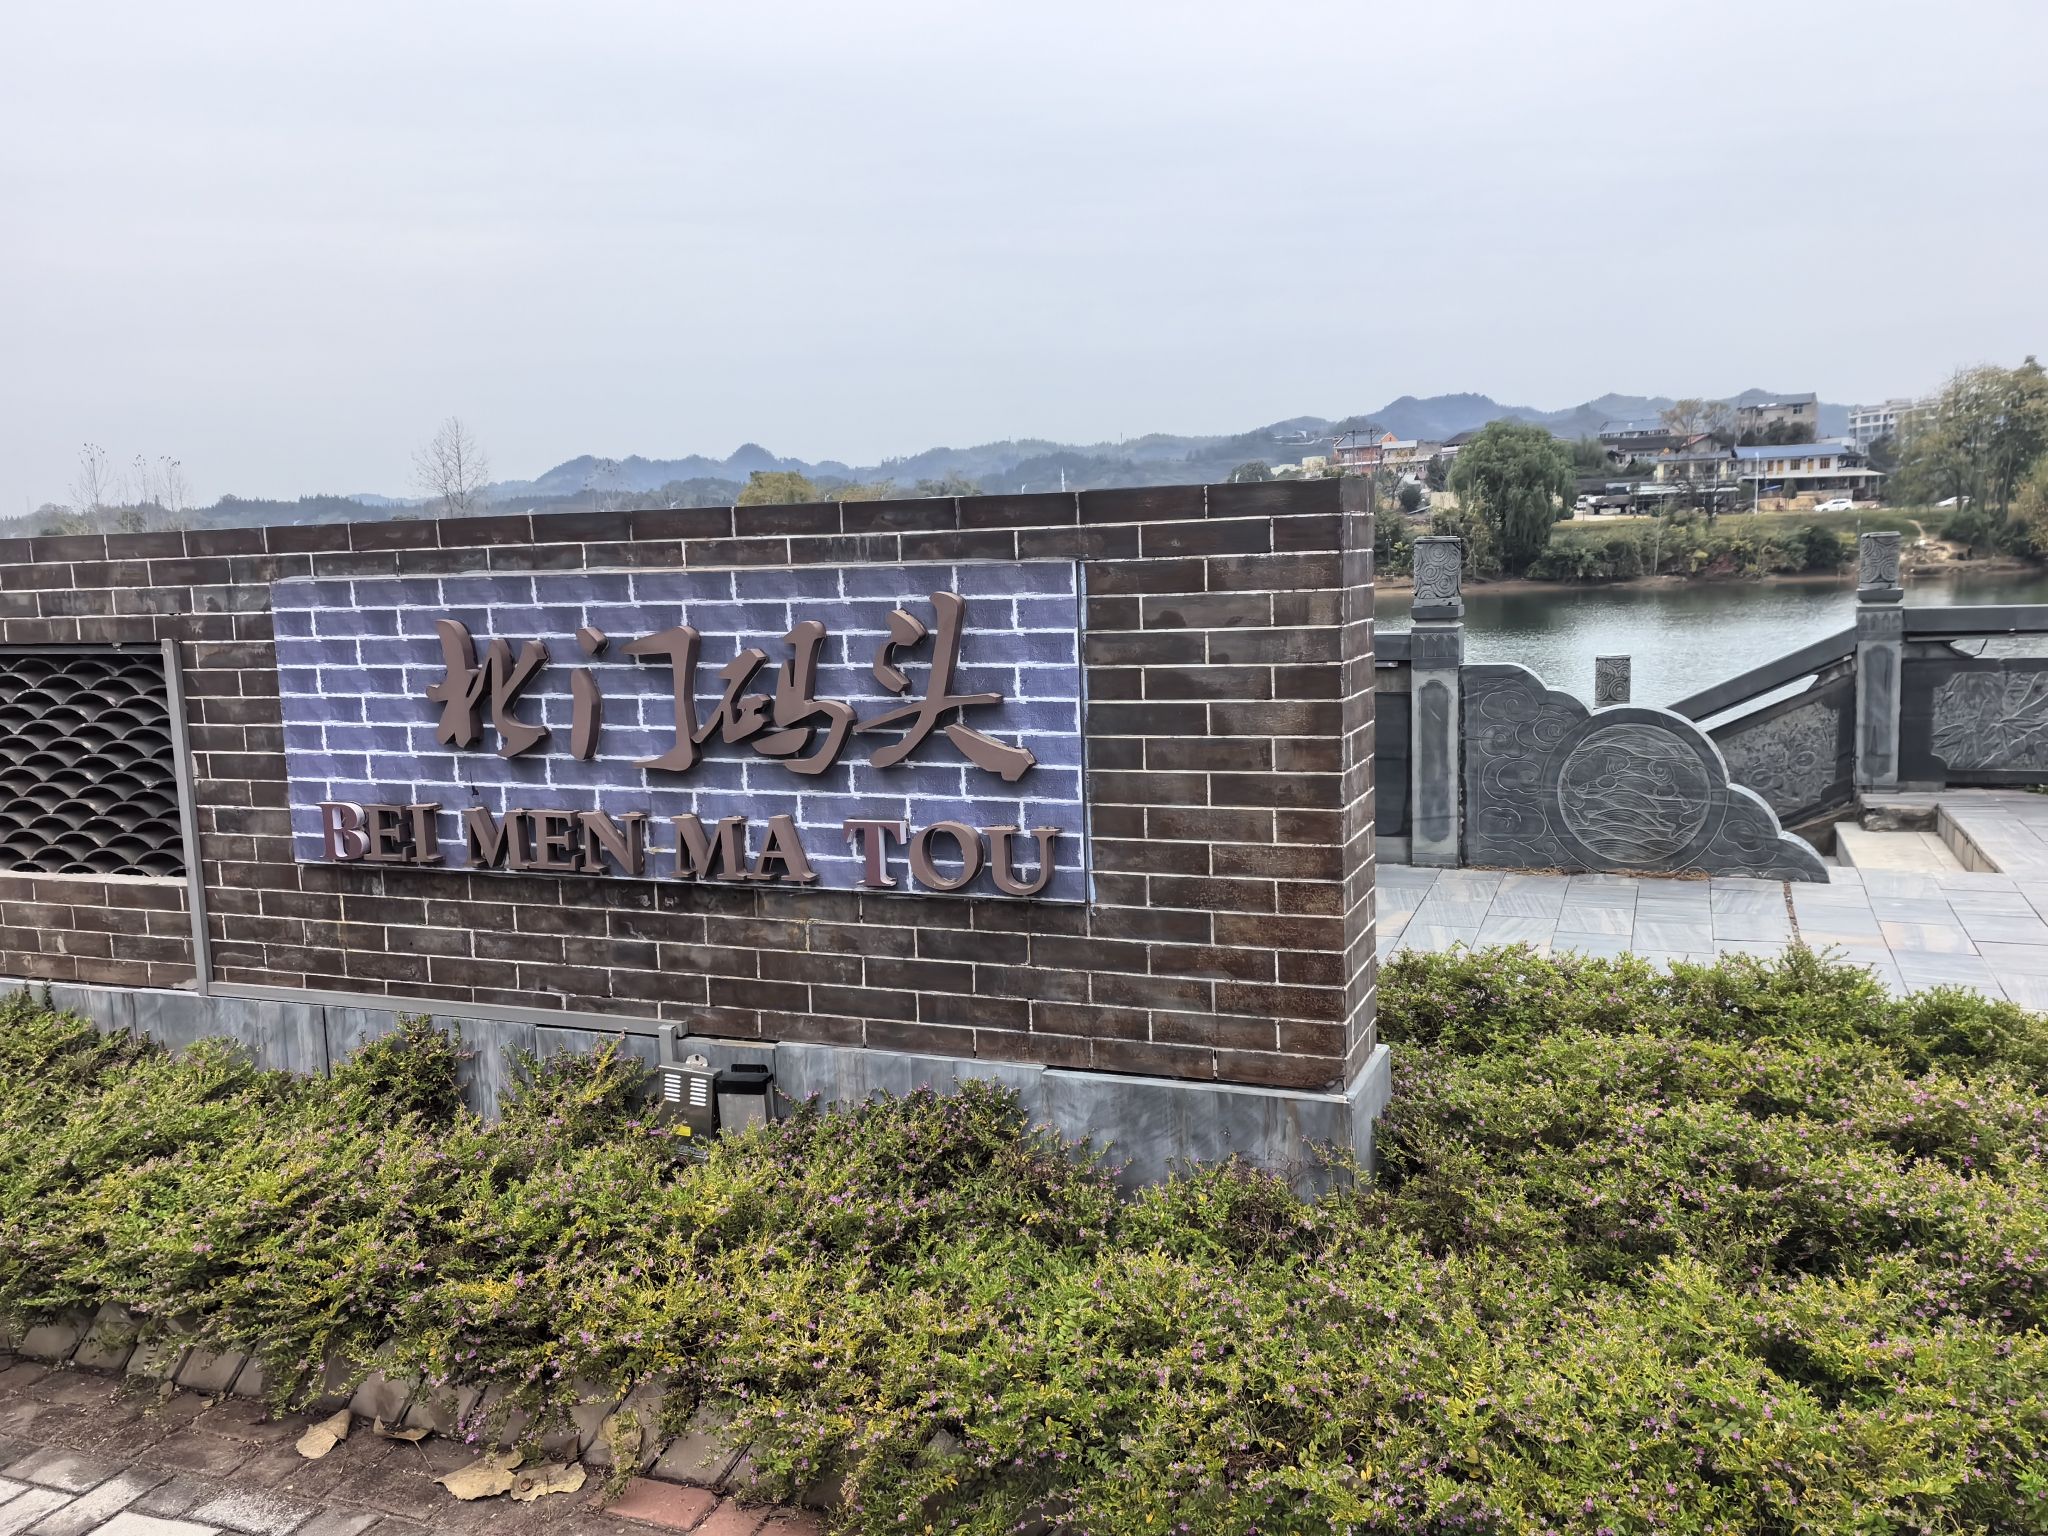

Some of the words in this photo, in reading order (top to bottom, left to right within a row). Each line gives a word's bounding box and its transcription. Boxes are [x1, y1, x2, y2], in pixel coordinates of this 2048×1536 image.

[426, 591, 1036, 782] 北门码头
[321, 801, 443, 863] BEI
[464, 806, 647, 875] MEN
[671, 813, 818, 883] MA
[843, 818, 1060, 896] TOU
